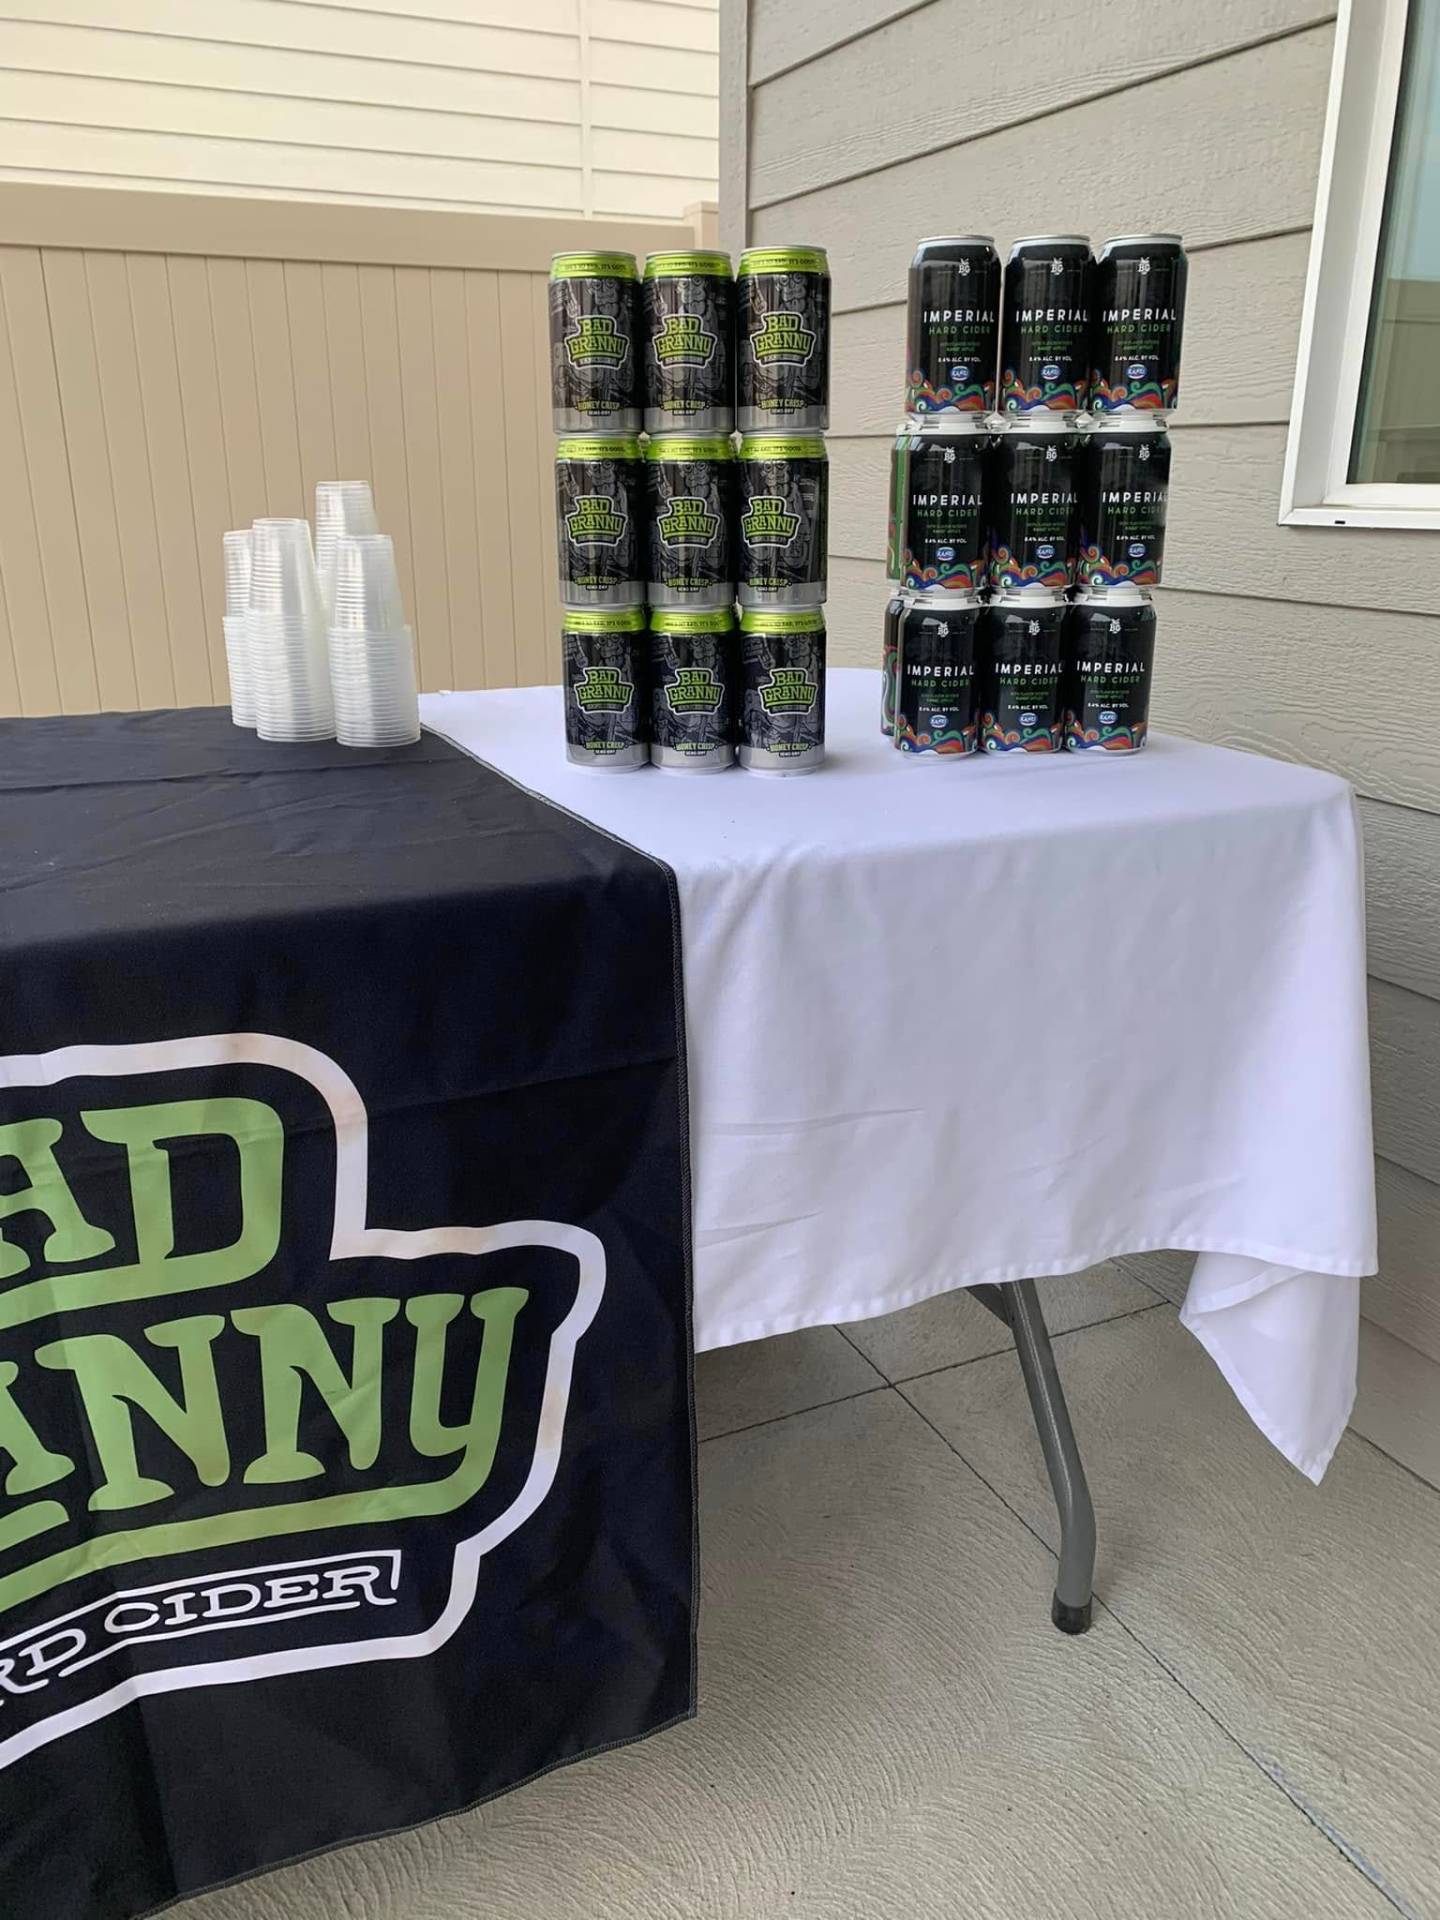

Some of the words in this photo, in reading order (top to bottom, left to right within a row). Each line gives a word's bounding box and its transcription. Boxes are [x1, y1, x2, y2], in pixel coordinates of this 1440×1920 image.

[767, 313, 799, 331] BAD
[923, 310, 995, 323] IMPERIAL
[1016, 309, 1088, 322] IMPERIAL
[1102, 308, 1177, 322] IMPERIAL
[581, 319, 613, 335] BAD
[668, 317, 700, 334] BAD
[928, 325, 957, 336] HARD
[1020, 324, 1049, 335] HARD
[1106, 323, 1135, 335] HARD
[570, 335, 627, 357] GRANNY
[656, 333, 714, 357] GRANNY
[754, 331, 812, 356] GRANNY
[912, 494, 983, 506] IMPERIAL
[1010, 492, 1078, 504] IMPERIAL
[578, 498, 610, 513] BAD
[671, 499, 702, 514] BAD
[753, 498, 782, 513] BAD
[917, 508, 943, 517] HARD
[1015, 507, 1044, 515] HARD
[1107, 506, 1136, 514] HARD
[569, 514, 626, 536] GRANNY
[660, 514, 718, 537] GRANNY
[744, 514, 797, 537] GRANNY
[907, 664, 974, 677] IMPERIAL
[995, 662, 1063, 675] IMPERIAL
[1076, 660, 1145, 673] IMPERIAL
[587, 670, 618, 684] BAD
[679, 671, 709, 685] BAD
[771, 671, 802, 685] BAD
[911, 678, 938, 687] HARD
[1000, 676, 1027, 685] HARD
[1080, 675, 1107, 684] HARD
[577, 684, 632, 705] GRANNY
[667, 685, 723, 706] GRANNY
[761, 685, 817, 707] GRANNY
[104, 1565, 398, 1633] CIDER
